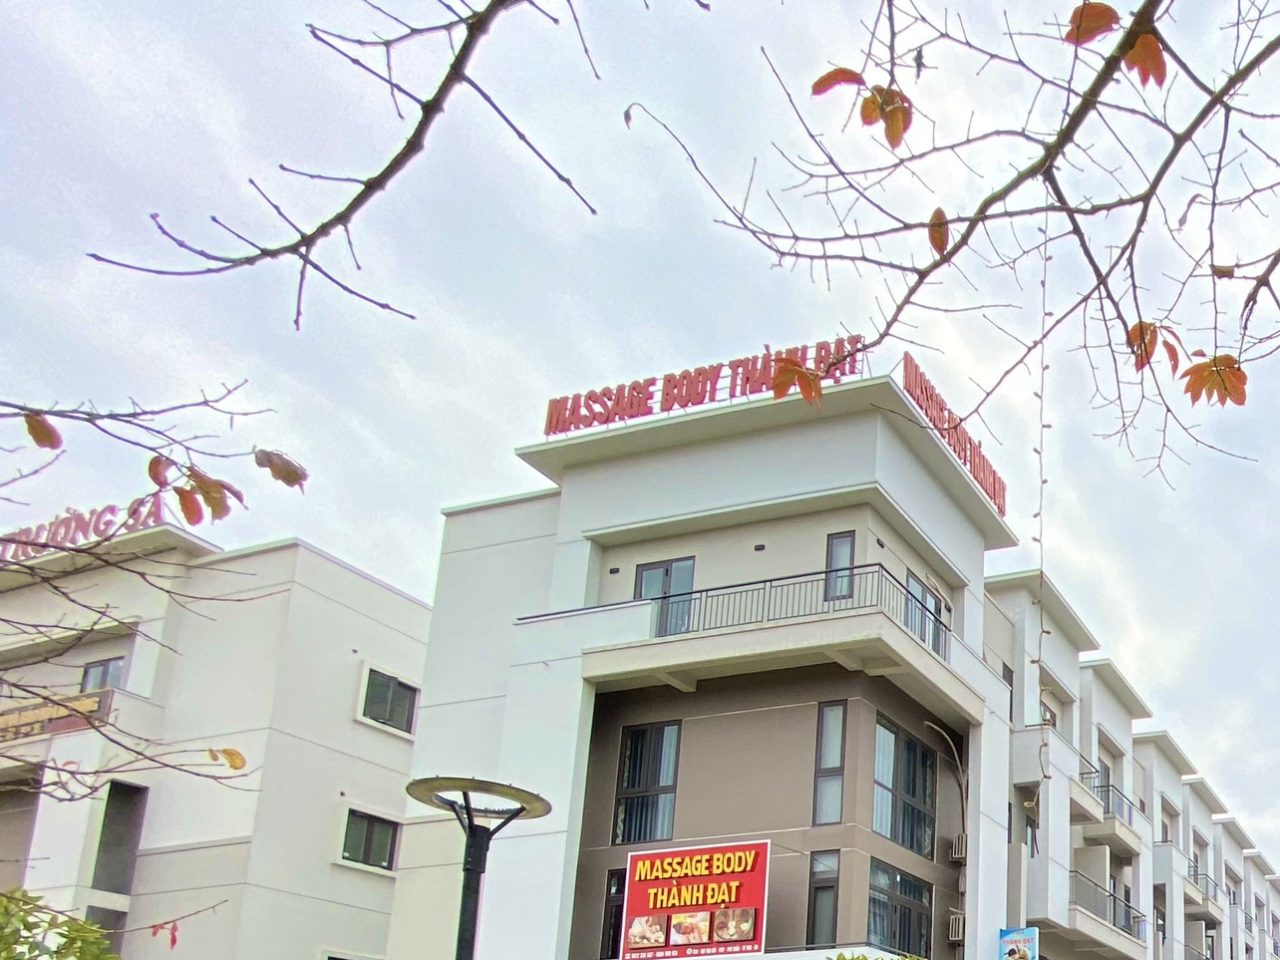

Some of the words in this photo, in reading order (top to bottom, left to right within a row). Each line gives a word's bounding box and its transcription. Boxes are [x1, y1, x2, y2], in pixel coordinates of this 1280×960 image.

[543, 377, 658, 436] MASSAGE
[660, 363, 723, 412] BODY
[729, 344, 808, 398] THÀ
[635, 854, 711, 881] MASSAGE
[713, 850, 756, 875] BODY
[648, 880, 705, 909] THÀNH
[706, 880, 740, 909] ĐẠT
